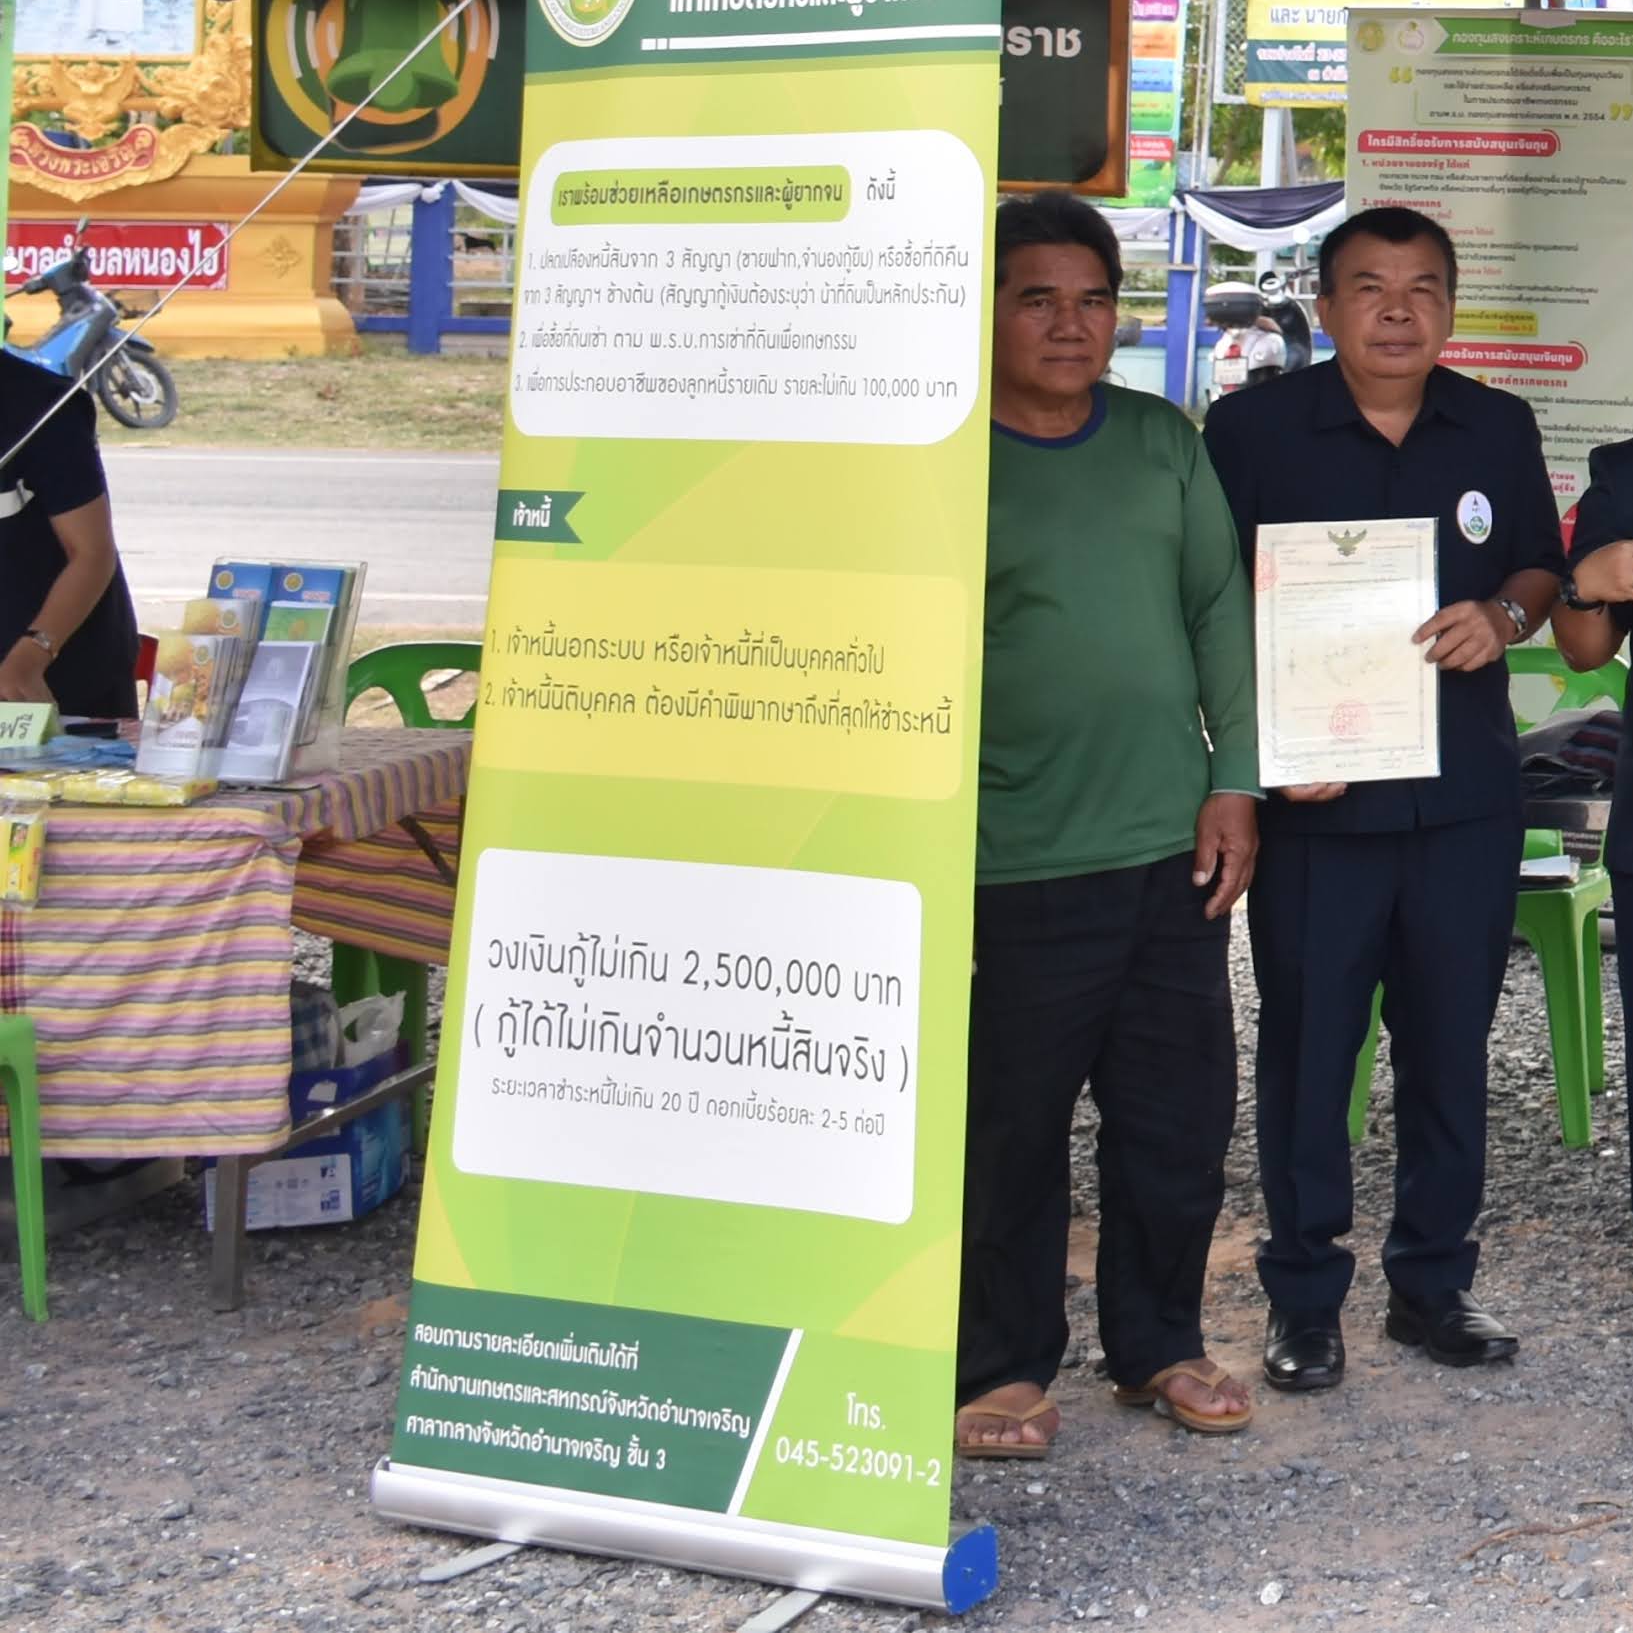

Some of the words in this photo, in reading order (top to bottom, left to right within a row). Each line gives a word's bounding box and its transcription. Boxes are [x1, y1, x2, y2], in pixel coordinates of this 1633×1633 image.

[1000, 25, 1082, 58] ราช
[557, 178, 843, 211] เราพร้อมช่วยเหลือเกษตรกรและผู้ยากจน
[866, 169, 896, 201] ดังนี้
[666, 249, 675, 268] 3
[682, 247, 731, 273] สัญญา
[544, 286, 551, 305] 3
[607, 280, 654, 304] ข้างต้น
[614, 331, 644, 349] ตาม
[784, 373, 856, 397] รายละไม่เกิน
[864, 377, 920, 398] 100,000
[926, 379, 957, 398] บาท
[512, 495, 551, 530] เจ้าหนี้
[490, 628, 501, 655] 1.
[507, 621, 644, 661] เจ้าหนี้นอกระบบ
[653, 629, 884, 677] หรือเจ้าหนี้ที่เป็นบุคคลทั่วไป
[485, 682, 497, 707] 2.
[502, 673, 636, 719] เจ้าหนี้นิติบุคคล
[645, 687, 952, 736] ต้องมีคำพิพากษาถึงที่สุดให้ชำระหนี้
[487, 933, 668, 987] วงเงินกู้ไม่เกิน
[683, 948, 842, 1001] 2,500,000
[854, 969, 901, 1007] บาท
[498, 997, 887, 1084] กู้ได้ไม่เกินจำนวนหนี้สินจริง
[491, 1075, 654, 1110] ระยะเวลาชำระหนี้ไม่เกิน
[661, 1091, 681, 1112] 20
[688, 1089, 699, 1115] ปี
[706, 1093, 815, 1127] ดอกเบี้ยร้อยละ
[821, 1108, 847, 1132] 2-5
[855, 1108, 884, 1136] ต่อปี
[414, 1323, 640, 1370] สอบถามรายละเอียดเพิ่มเติมได้ที่
[410, 1364, 751, 1439] สำนักงานเกษตรและสหกรณ์จังหวัดอำนาจเจริญ
[846, 1391, 887, 1432] โทร.
[406, 1414, 620, 1468] ศาลากลางจังหวัดอำนาจเจริญ
[627, 1434, 649, 1468] ชั้น
[656, 1449, 666, 1470] 3
[775, 1437, 942, 1488] 045-523091-2
